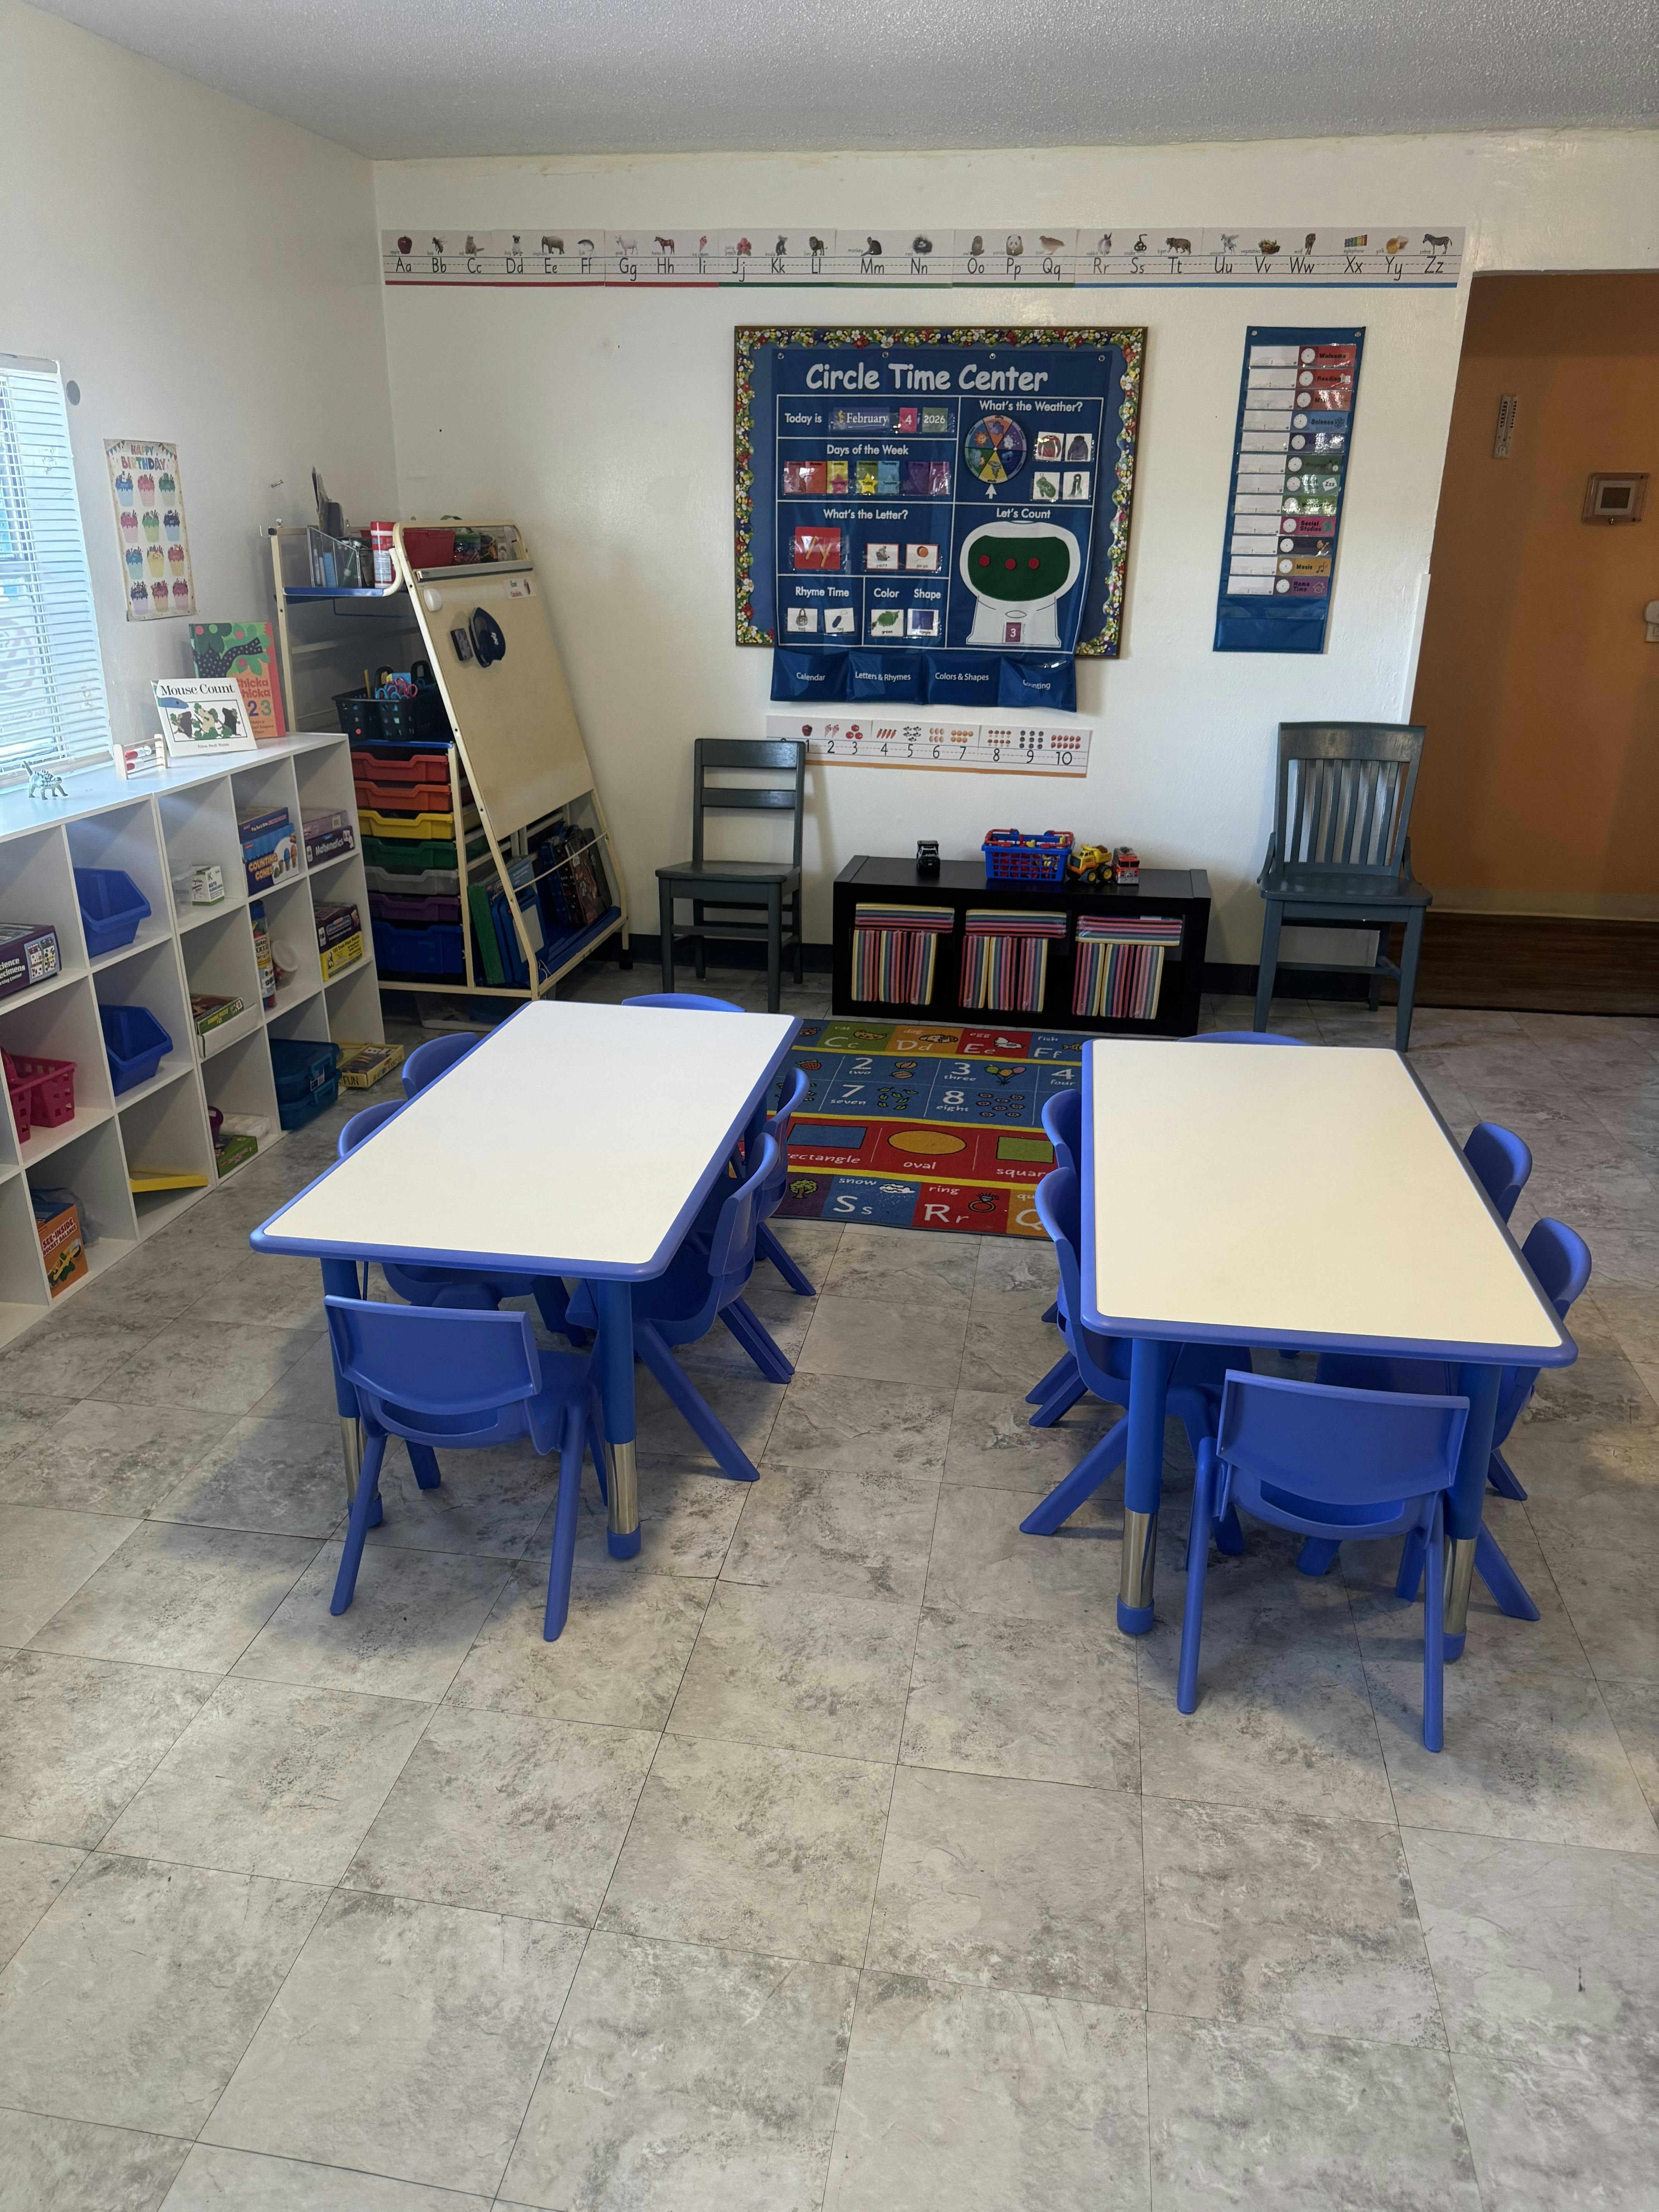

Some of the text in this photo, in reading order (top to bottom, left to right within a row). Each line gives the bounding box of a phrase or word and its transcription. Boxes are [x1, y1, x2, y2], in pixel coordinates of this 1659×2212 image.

[396, 256, 1444, 282] Aa Bb Cc Dd Ee Ff Gg Hh Ii Jj Kk Ll Mm Nn Oo Pp Qq Rr Ss Tt Uu Vv Ww Xx Yy Zz
[806, 362, 1048, 392] Circle Time Center
[979, 400, 1083, 412] What's the Weather?
[785, 412, 945, 426] Today is February 4 2026
[131, 444, 154, 456] HAPPY
[827, 444, 909, 455] Days of the Week
[121, 456, 166, 471] BIRTHDAY
[823, 509, 908, 520] What's the Letter?
[996, 508, 1051, 519] Let's Count
[801, 535, 832, 568] Yy
[795, 587, 849, 598] Rhyme Time
[874, 588, 899, 598] Color
[914, 589, 941, 601] Shape
[1010, 628, 1016, 638] 3
[797, 672, 826, 682] Calendar
[855, 672, 878, 681] Letters
[884, 673, 911, 682] Rhymes
[935, 672, 957, 681] Colors
[964, 673, 989, 682] Shapes
[160, 682, 235, 696] Mouse Count
[1023, 679, 1051, 690] Counting
[242, 689, 271, 698] hicka
[247, 699, 271, 717] 2 3
[805, 739, 1072, 765] 1 2 3 4 5 6 7 8 9 10
[316, 838, 344, 856] Mathematics
[249, 853, 278, 872] COUNTING
[255, 866, 274, 881] CONES
[0, 958, 19, 970] cience
[0, 965, 26, 979] ecimens
[0, 972, 22, 986] rting Center
[852, 1057, 873, 1070] 2
[951, 1062, 970, 1075] 3
[343, 1075, 359, 1085] FUN
[1051, 1068, 1075, 1080] 4
[842, 1084, 866, 1098] 7
[943, 1090, 965, 1105] 8
[903, 1162, 936, 1170] oval
[996, 1168, 1047, 1178] squar
[929, 1185, 960, 1195] ring
[43, 1226, 76, 1256] BUCKET BALANCE
